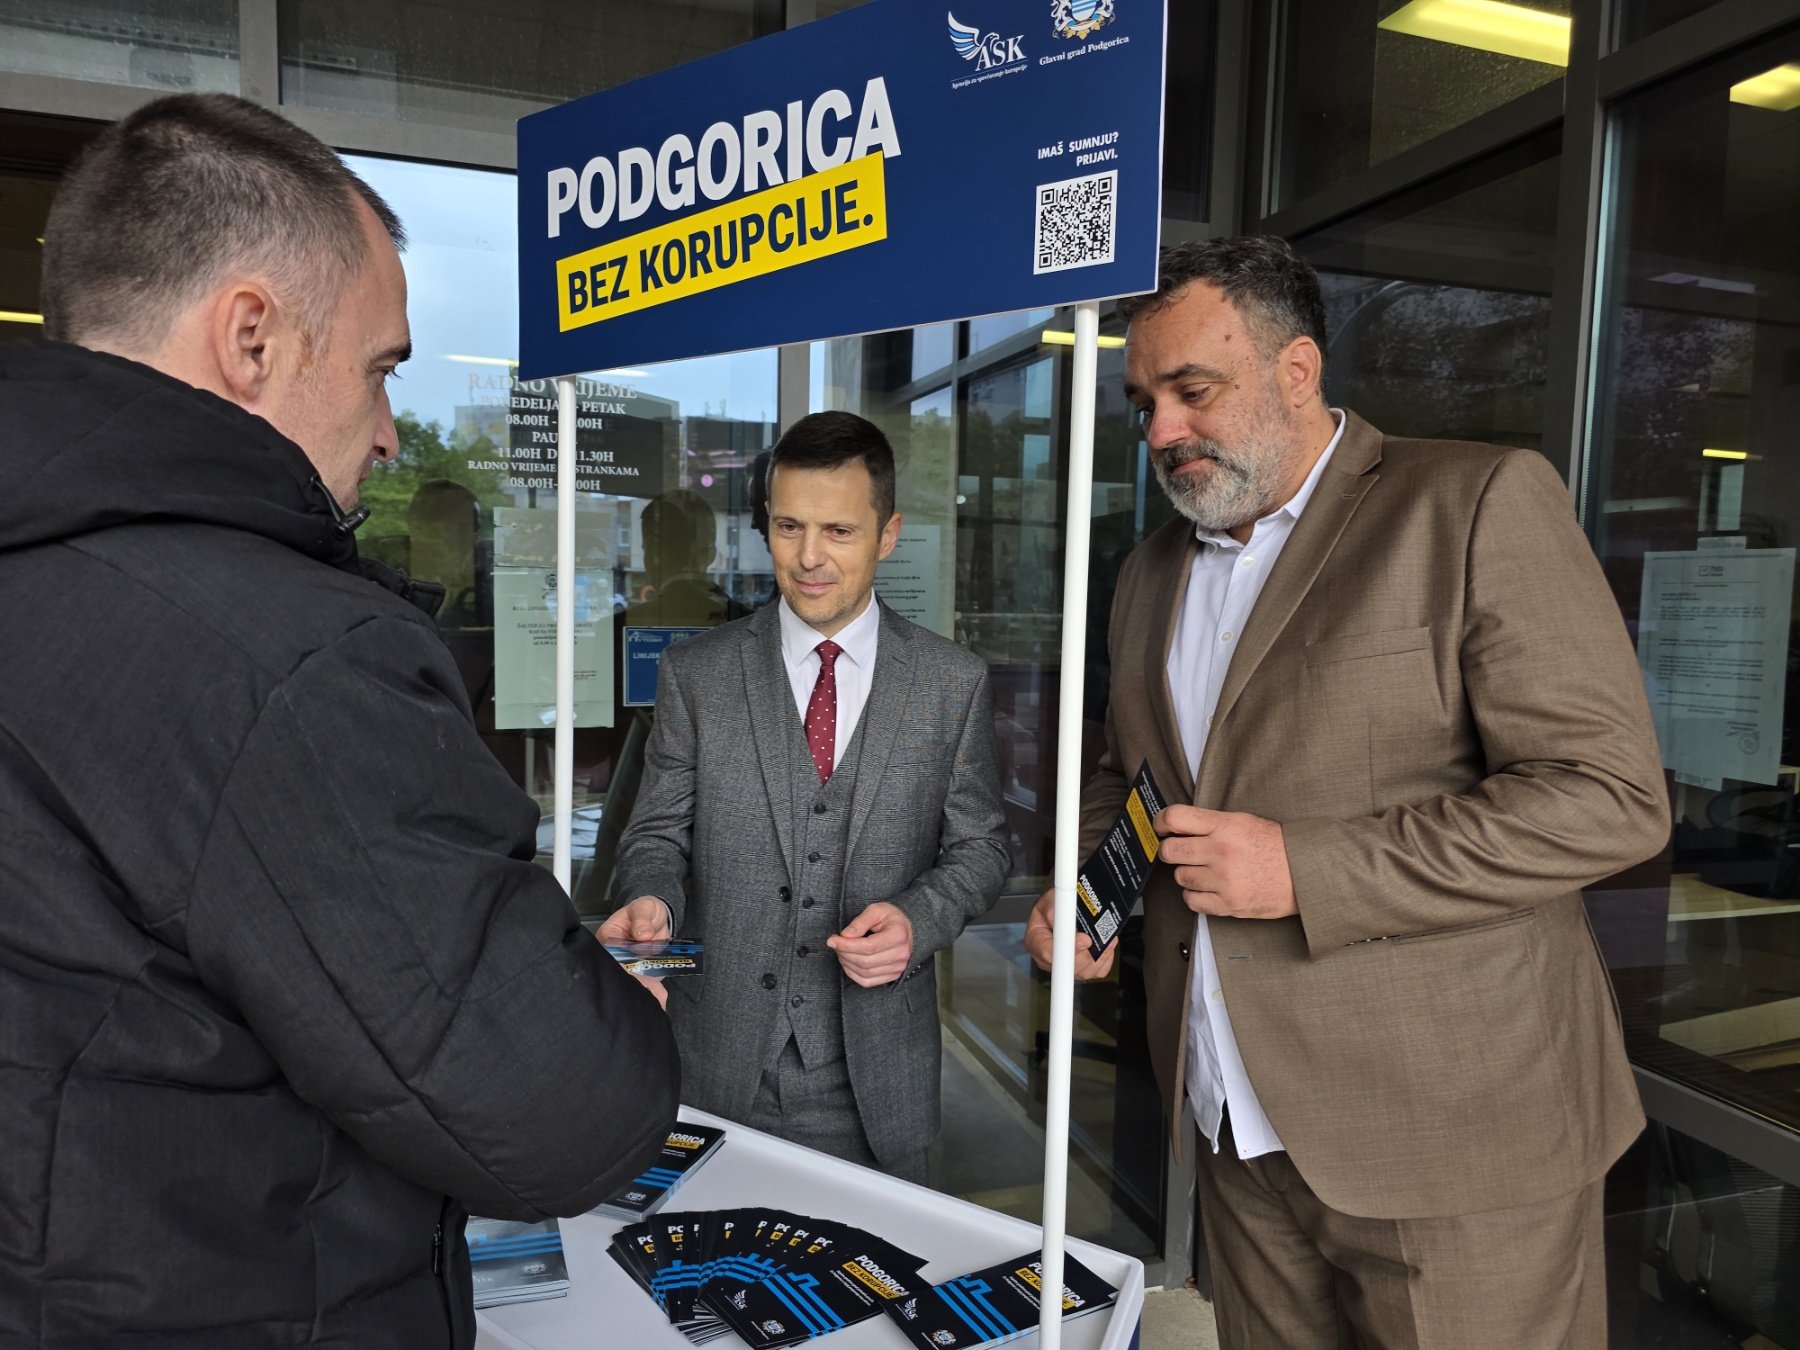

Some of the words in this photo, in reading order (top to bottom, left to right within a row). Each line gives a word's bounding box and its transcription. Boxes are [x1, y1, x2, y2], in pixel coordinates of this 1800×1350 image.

[975, 35, 1027, 71] ASK
[1039, 53, 1066, 66] Glavni
[1067, 46, 1086, 60] grad
[1088, 36, 1130, 54] Podgorica
[547, 76, 901, 238] PODGORICA
[1038, 141, 1064, 160] IMAŠ
[1069, 131, 1119, 153] SUMNJU?
[1076, 148, 1118, 167] PRIJAVI.
[568, 253, 630, 314] BEZ
[639, 179, 875, 293] KORUPCIJE.
[551, 379, 639, 399] VIJEME
[505, 413, 549, 427] 08.00H
[582, 401, 626, 415] PETAK
[499, 447, 541, 459] 11.00H
[468, 460, 509, 471] RADNO
[511, 462, 557, 473] VRIJEME
[855, 1255, 910, 1297] PODGORICA
